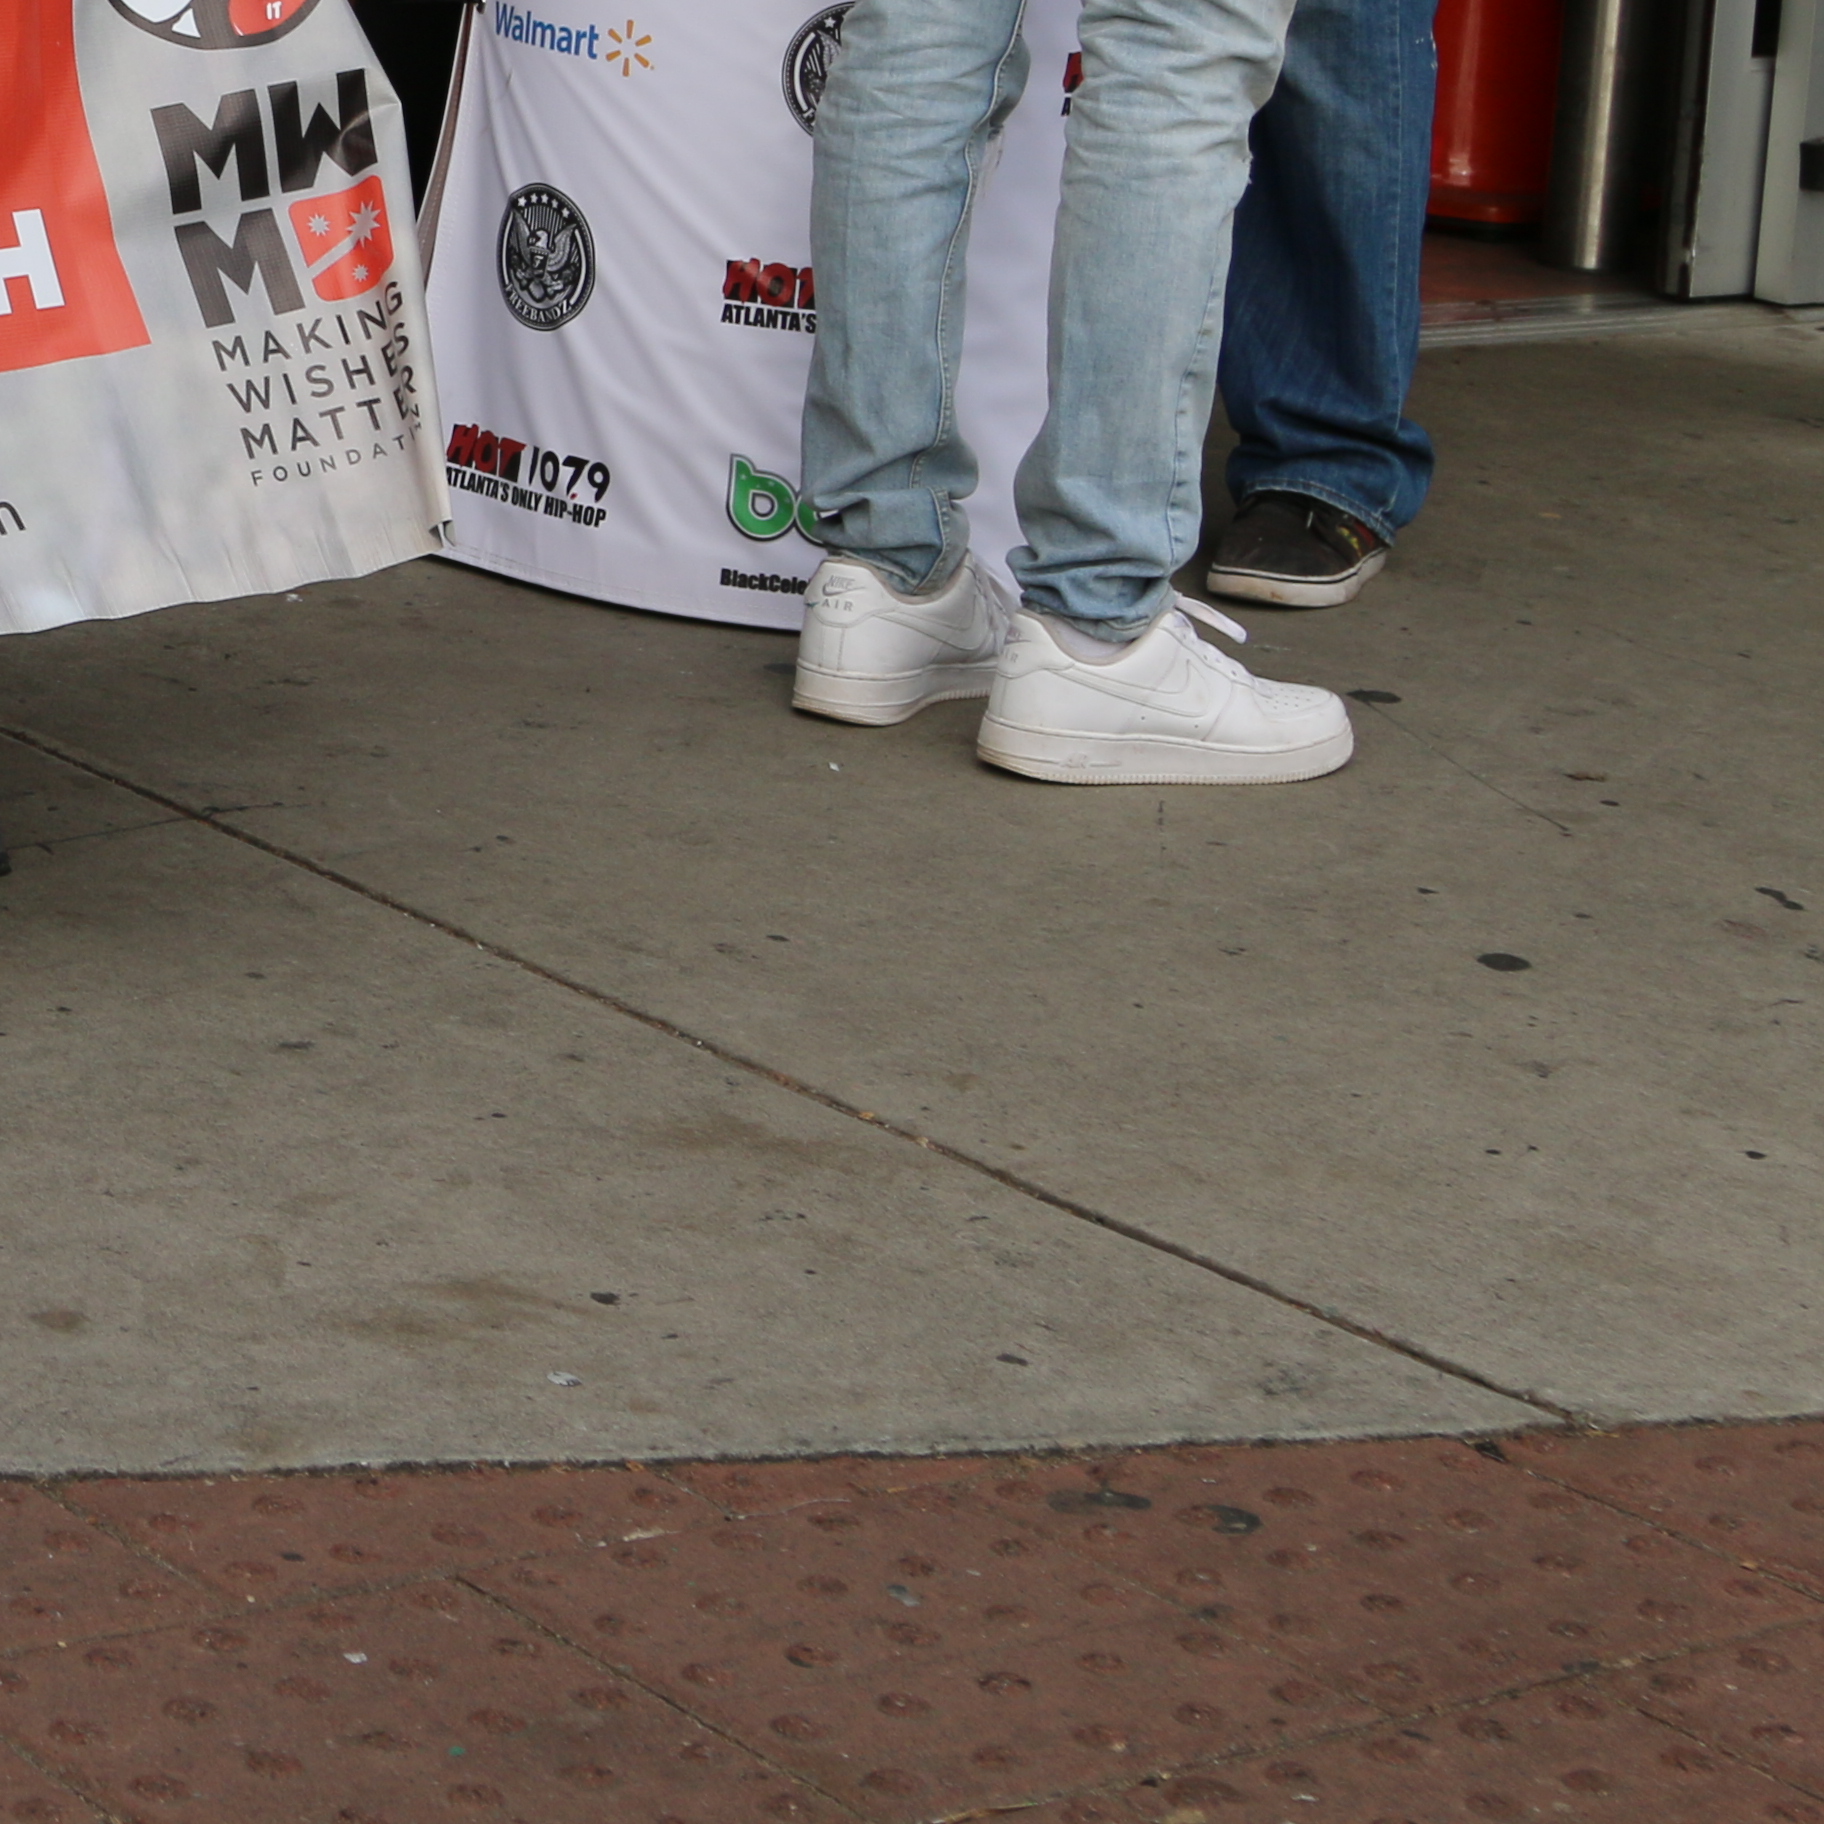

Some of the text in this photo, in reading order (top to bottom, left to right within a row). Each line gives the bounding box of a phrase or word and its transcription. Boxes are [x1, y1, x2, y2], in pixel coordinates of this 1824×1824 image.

[266, 1, 282, 20] IT
[495, 0, 600, 60] Walmart
[150, 68, 378, 215] MW
[212, 281, 403, 372] MAKING
[721, 304, 817, 333] ATLANTA'S
[226, 322, 410, 413] WISHES
[240, 365, 417, 459] MATTER
[250, 403, 420, 486] FOUNDATIN
[446, 424, 611, 504] HOT 107.9
[512, 485, 543, 512] ONLY
[544, 495, 607, 528] HIP-HOP
[720, 568, 812, 595] BlackCele
[822, 598, 854, 612] AIR
[828, 575, 856, 590] NIKE
